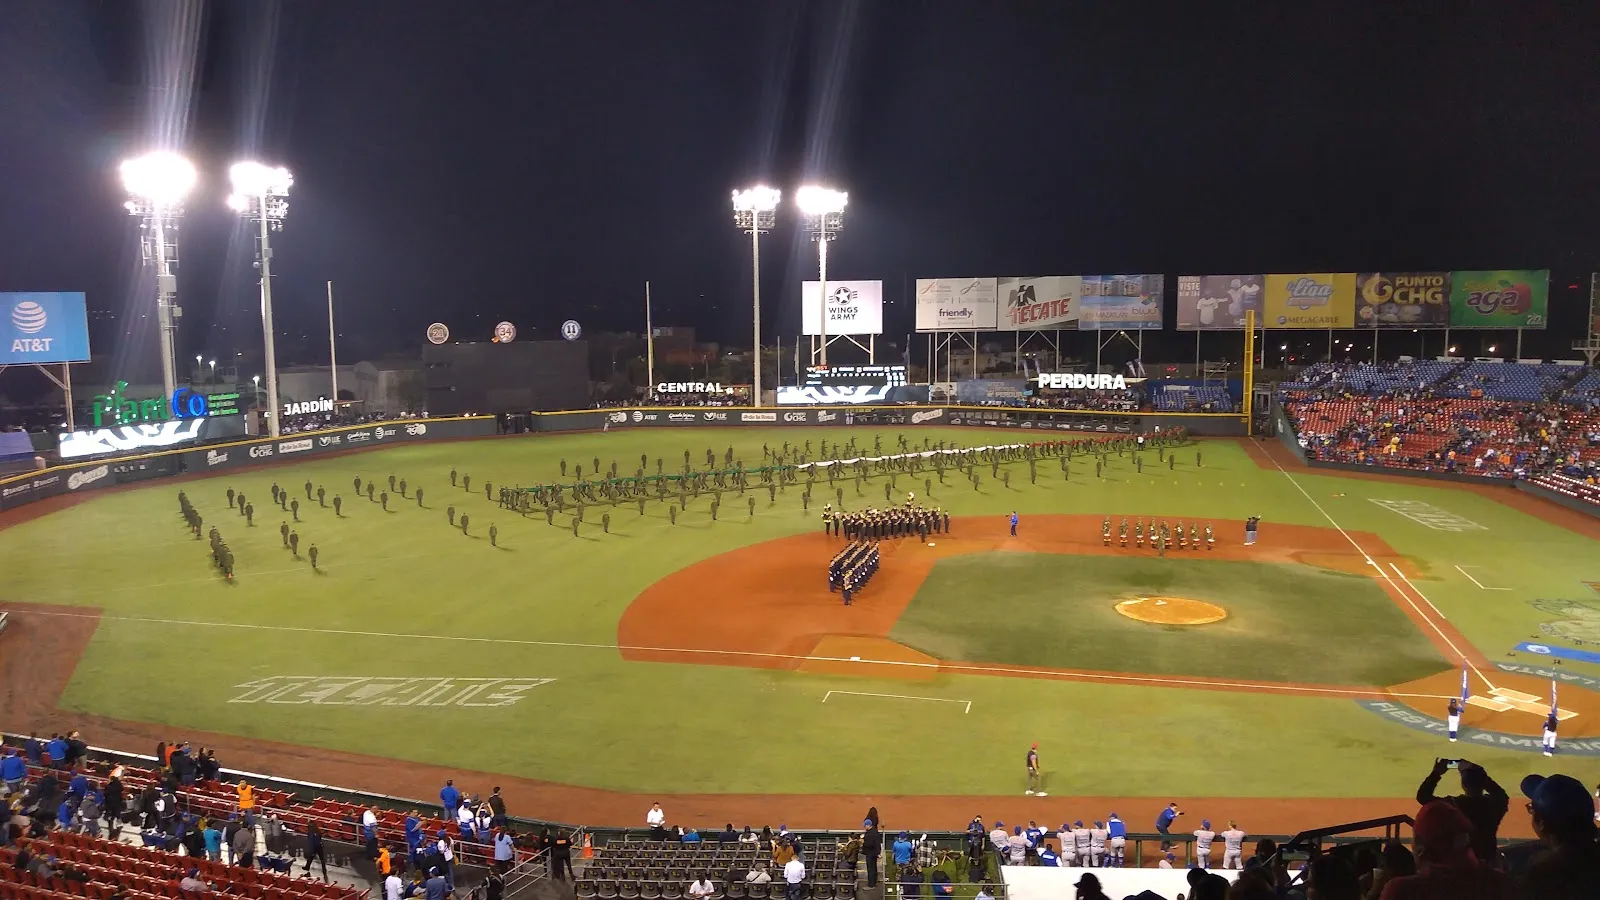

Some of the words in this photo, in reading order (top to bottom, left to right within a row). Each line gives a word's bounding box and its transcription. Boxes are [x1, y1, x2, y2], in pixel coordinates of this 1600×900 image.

[1179, 282, 1200, 291] VISTE
[1396, 276, 1444, 287] PUNTO
[1393, 287, 1443, 305] CHG
[1466, 290, 1519, 315] aga
[828, 306, 858, 314] WINGS
[1009, 297, 1072, 326] TECATE
[1287, 316, 1340, 324] MEGACABLE
[567, 325, 576, 333] 11
[11, 338, 53, 352] AT&T
[657, 382, 724, 393] CENTRAL
[1038, 374, 1126, 390] PERDURA
[284, 397, 334, 416] JARDÍN
